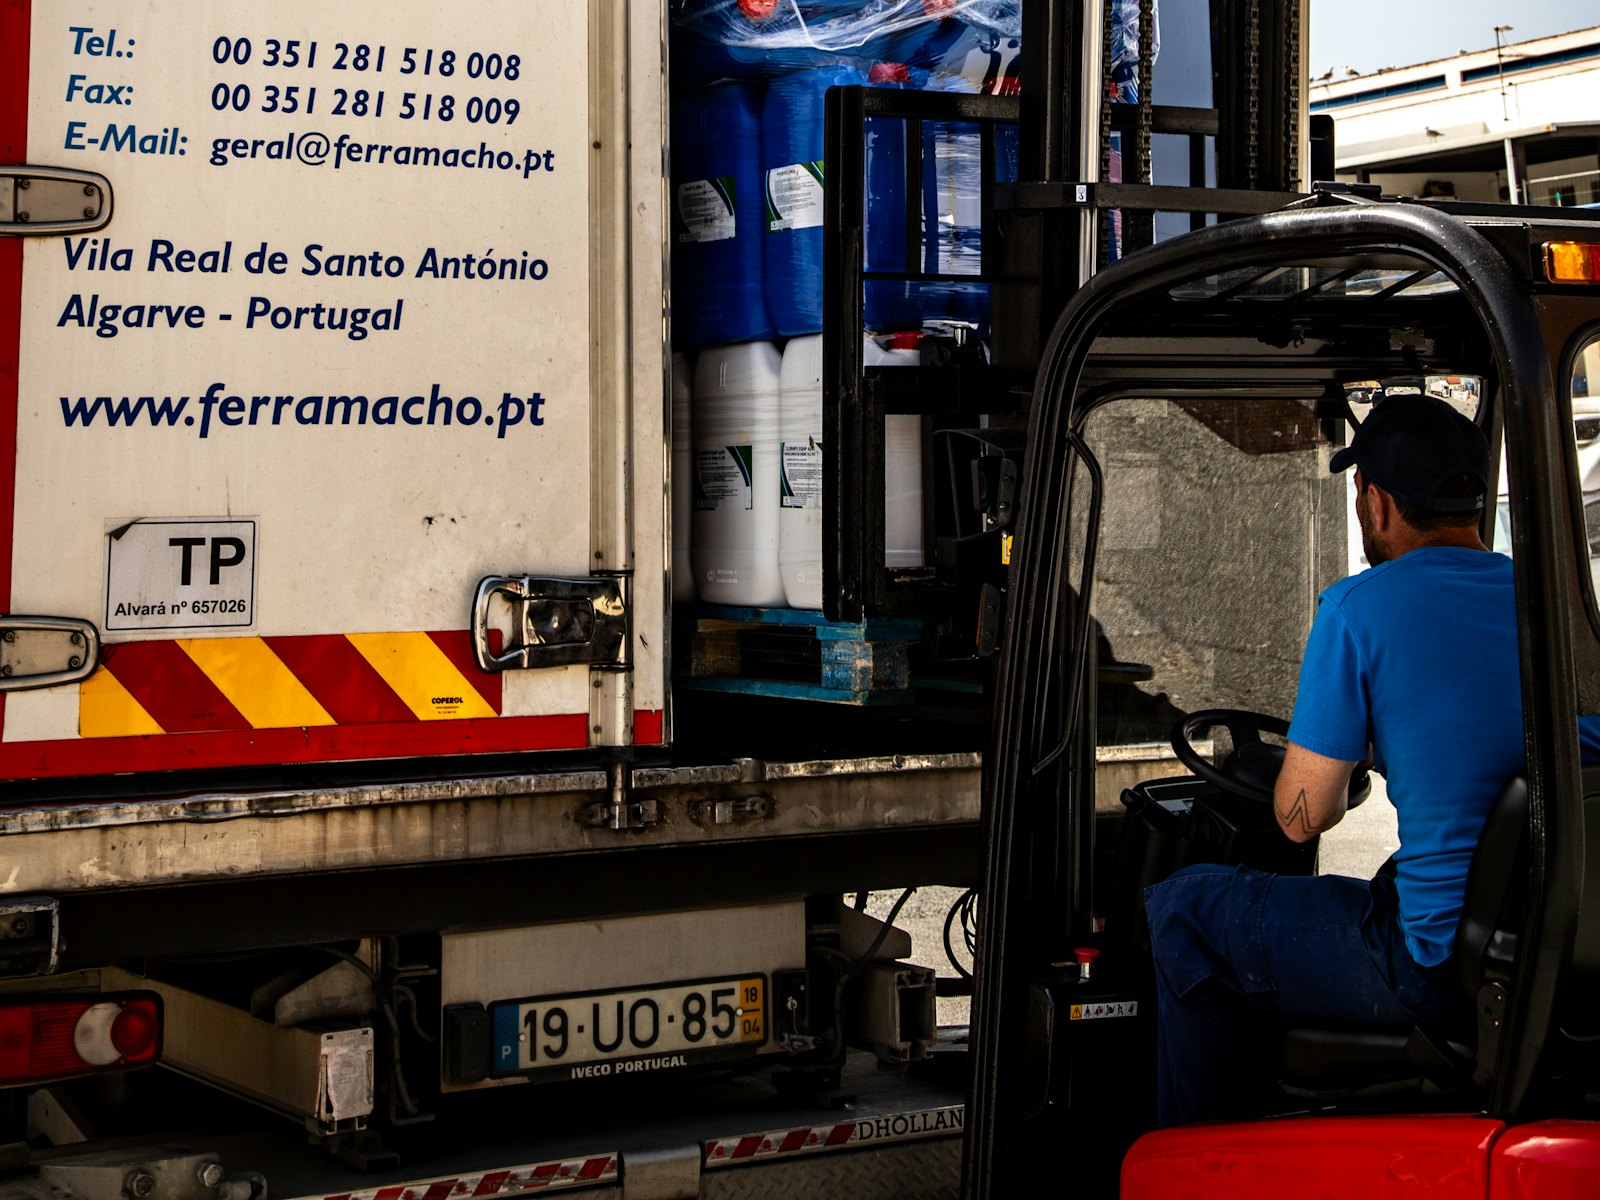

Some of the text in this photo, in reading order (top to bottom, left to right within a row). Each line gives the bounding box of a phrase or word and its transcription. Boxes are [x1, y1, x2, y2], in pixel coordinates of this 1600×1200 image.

[68, 26, 521, 81] Tel.: 00 351 281 518 008
[65, 74, 521, 125] Fax: 00 351 281 518 009
[63, 121, 555, 179] E-Mail: geral@ferramacho.pt
[63, 237, 549, 281] Vila Real de Santo António
[56, 293, 206, 339] Algarve
[245, 296, 404, 341] Portugal
[59, 382, 546, 439] www.ferramacho.pt
[168, 536, 246, 586] TP
[114, 601, 166, 617] Alvará
[191, 599, 246, 614] 657026
[431, 696, 464, 705] COPEROL
[743, 986, 758, 1003] 18
[742, 1018, 761, 1036] 04
[501, 1043, 512, 1060] P
[571, 1055, 688, 1080] IVECO PORTUGAL
